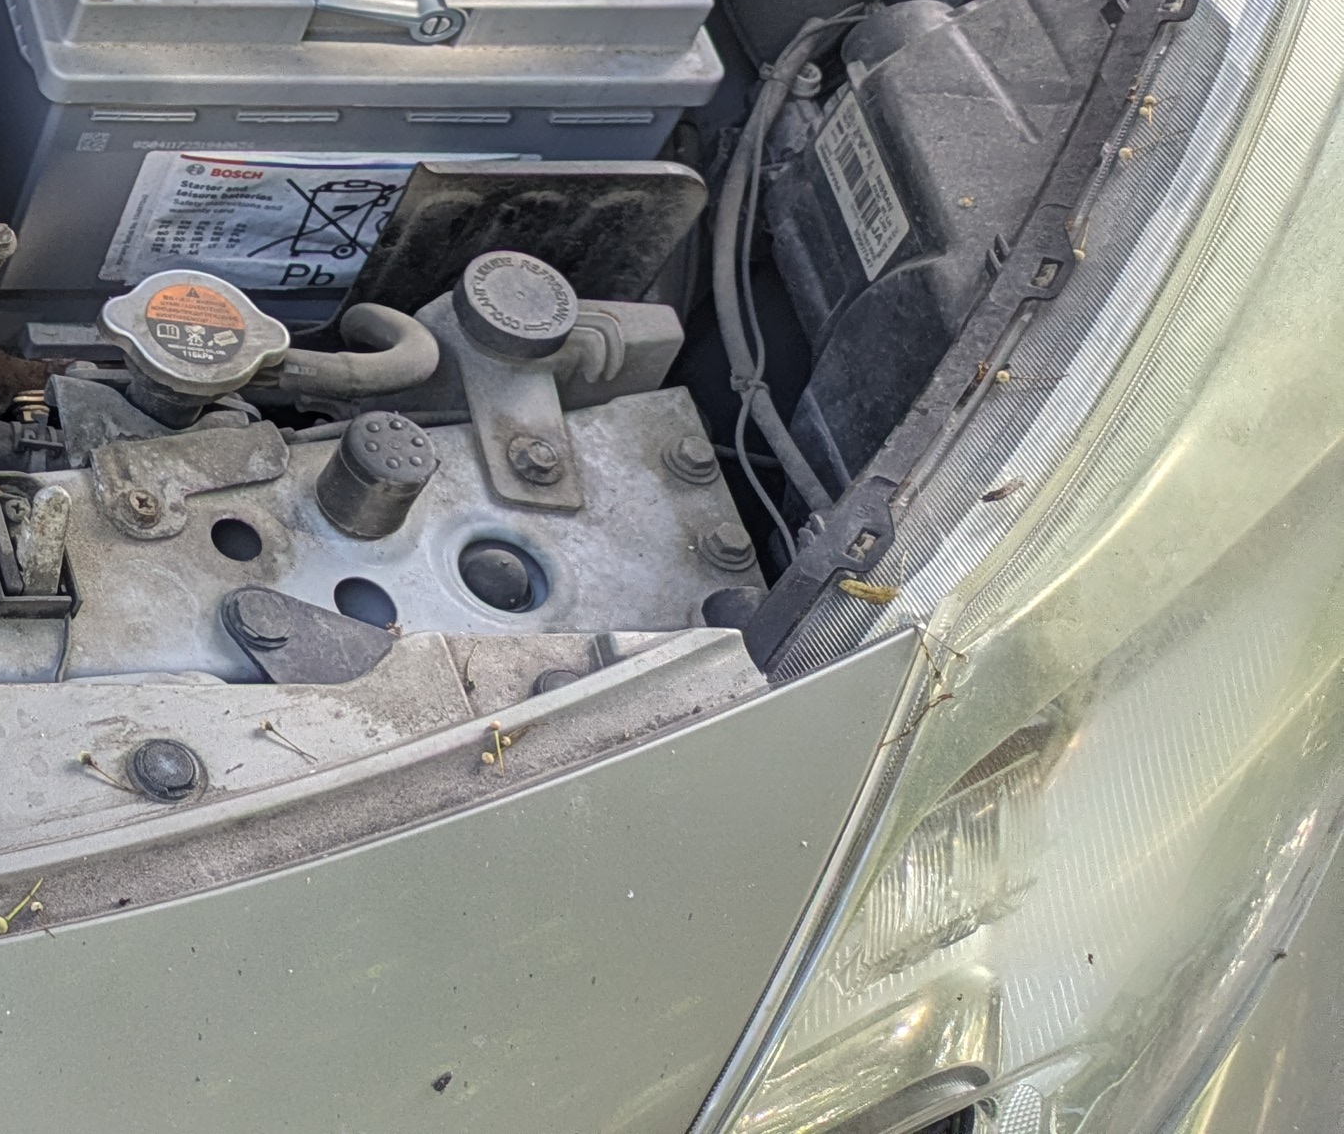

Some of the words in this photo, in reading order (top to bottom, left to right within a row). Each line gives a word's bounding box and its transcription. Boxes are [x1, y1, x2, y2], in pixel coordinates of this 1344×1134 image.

[210, 168, 264, 179] BOSCH
[180, 180, 223, 191] Starter
[279, 263, 336, 286] Pb
